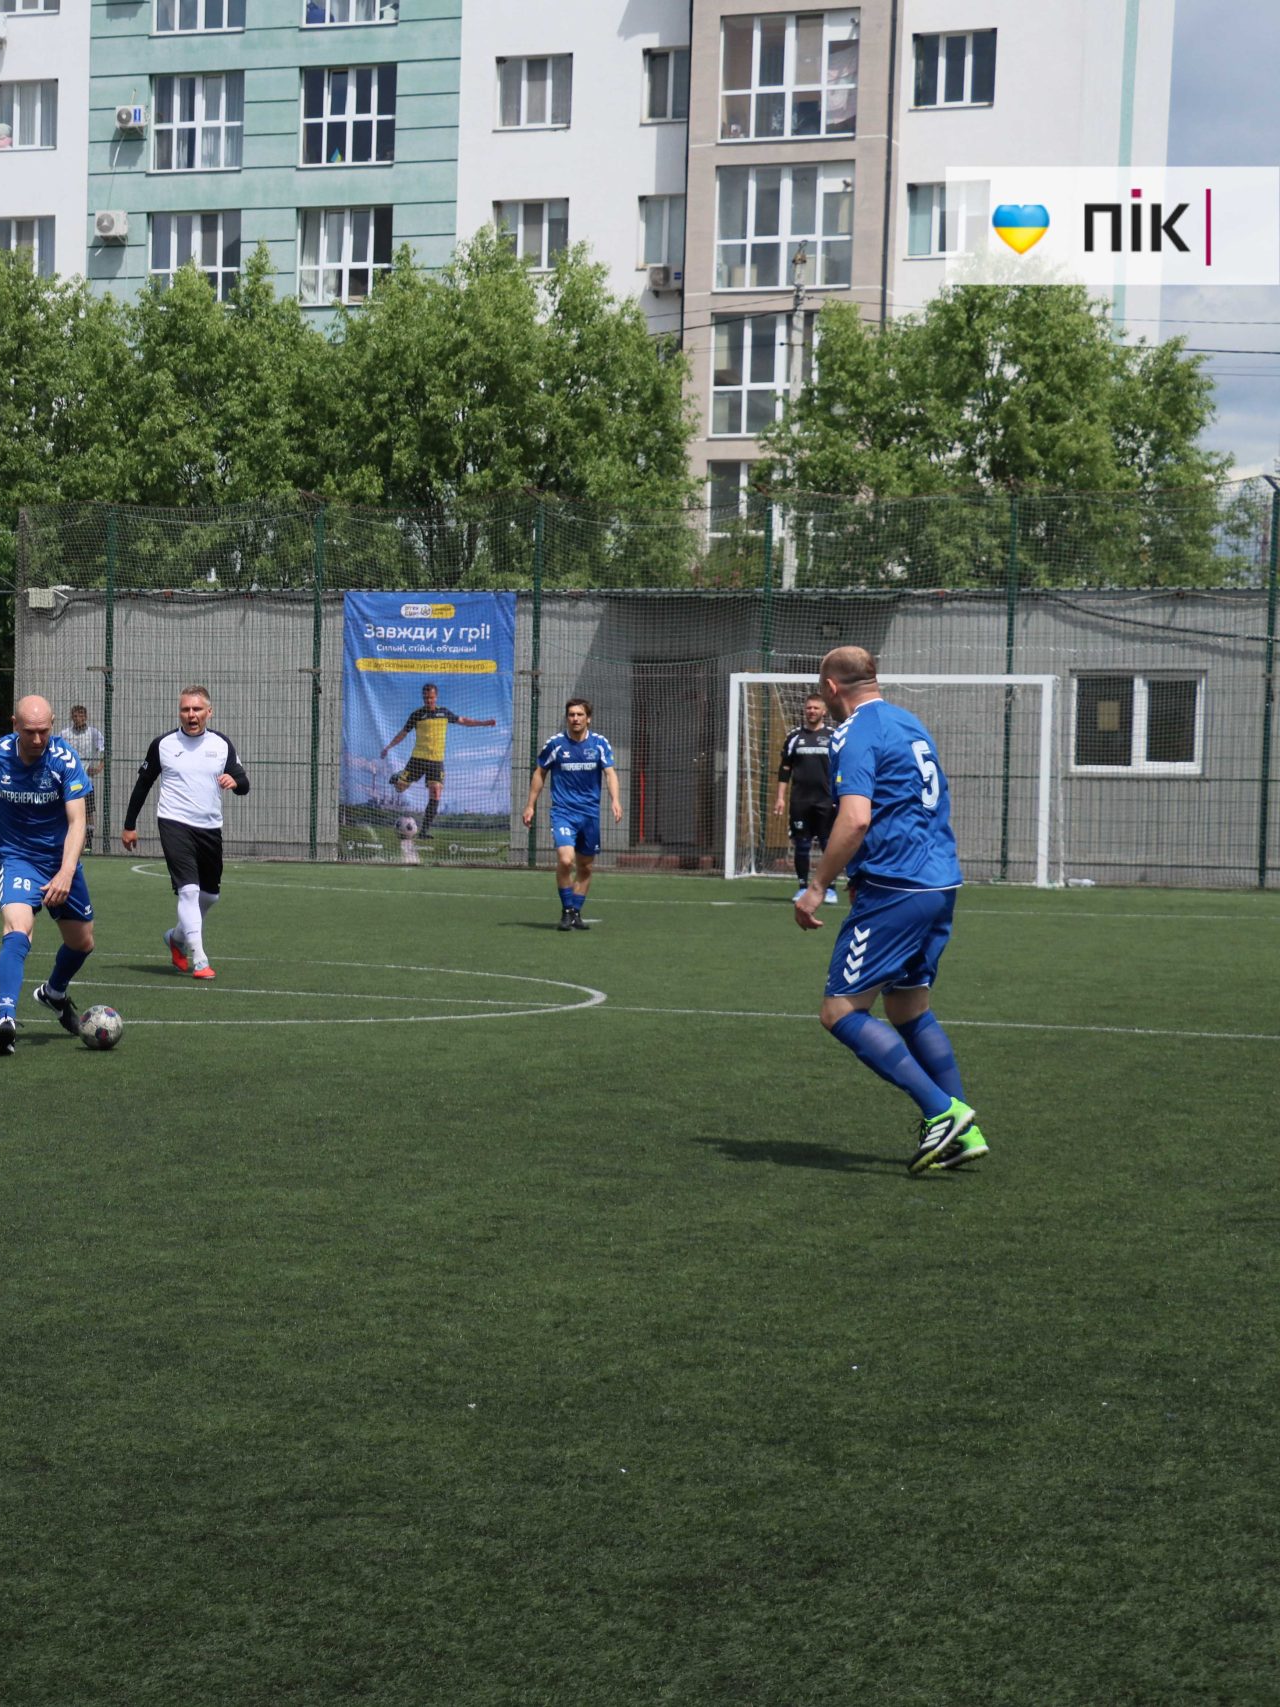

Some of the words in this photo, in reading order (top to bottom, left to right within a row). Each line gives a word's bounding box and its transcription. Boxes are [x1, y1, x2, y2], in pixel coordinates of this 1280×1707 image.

[364, 623, 438, 640] Завжди
[442, 627, 454, 643] у
[459, 623, 491, 643] грі!
[376, 643, 407, 653] Сильні,
[912, 740, 940, 809] 5
[12, 876, 31, 891] 28
